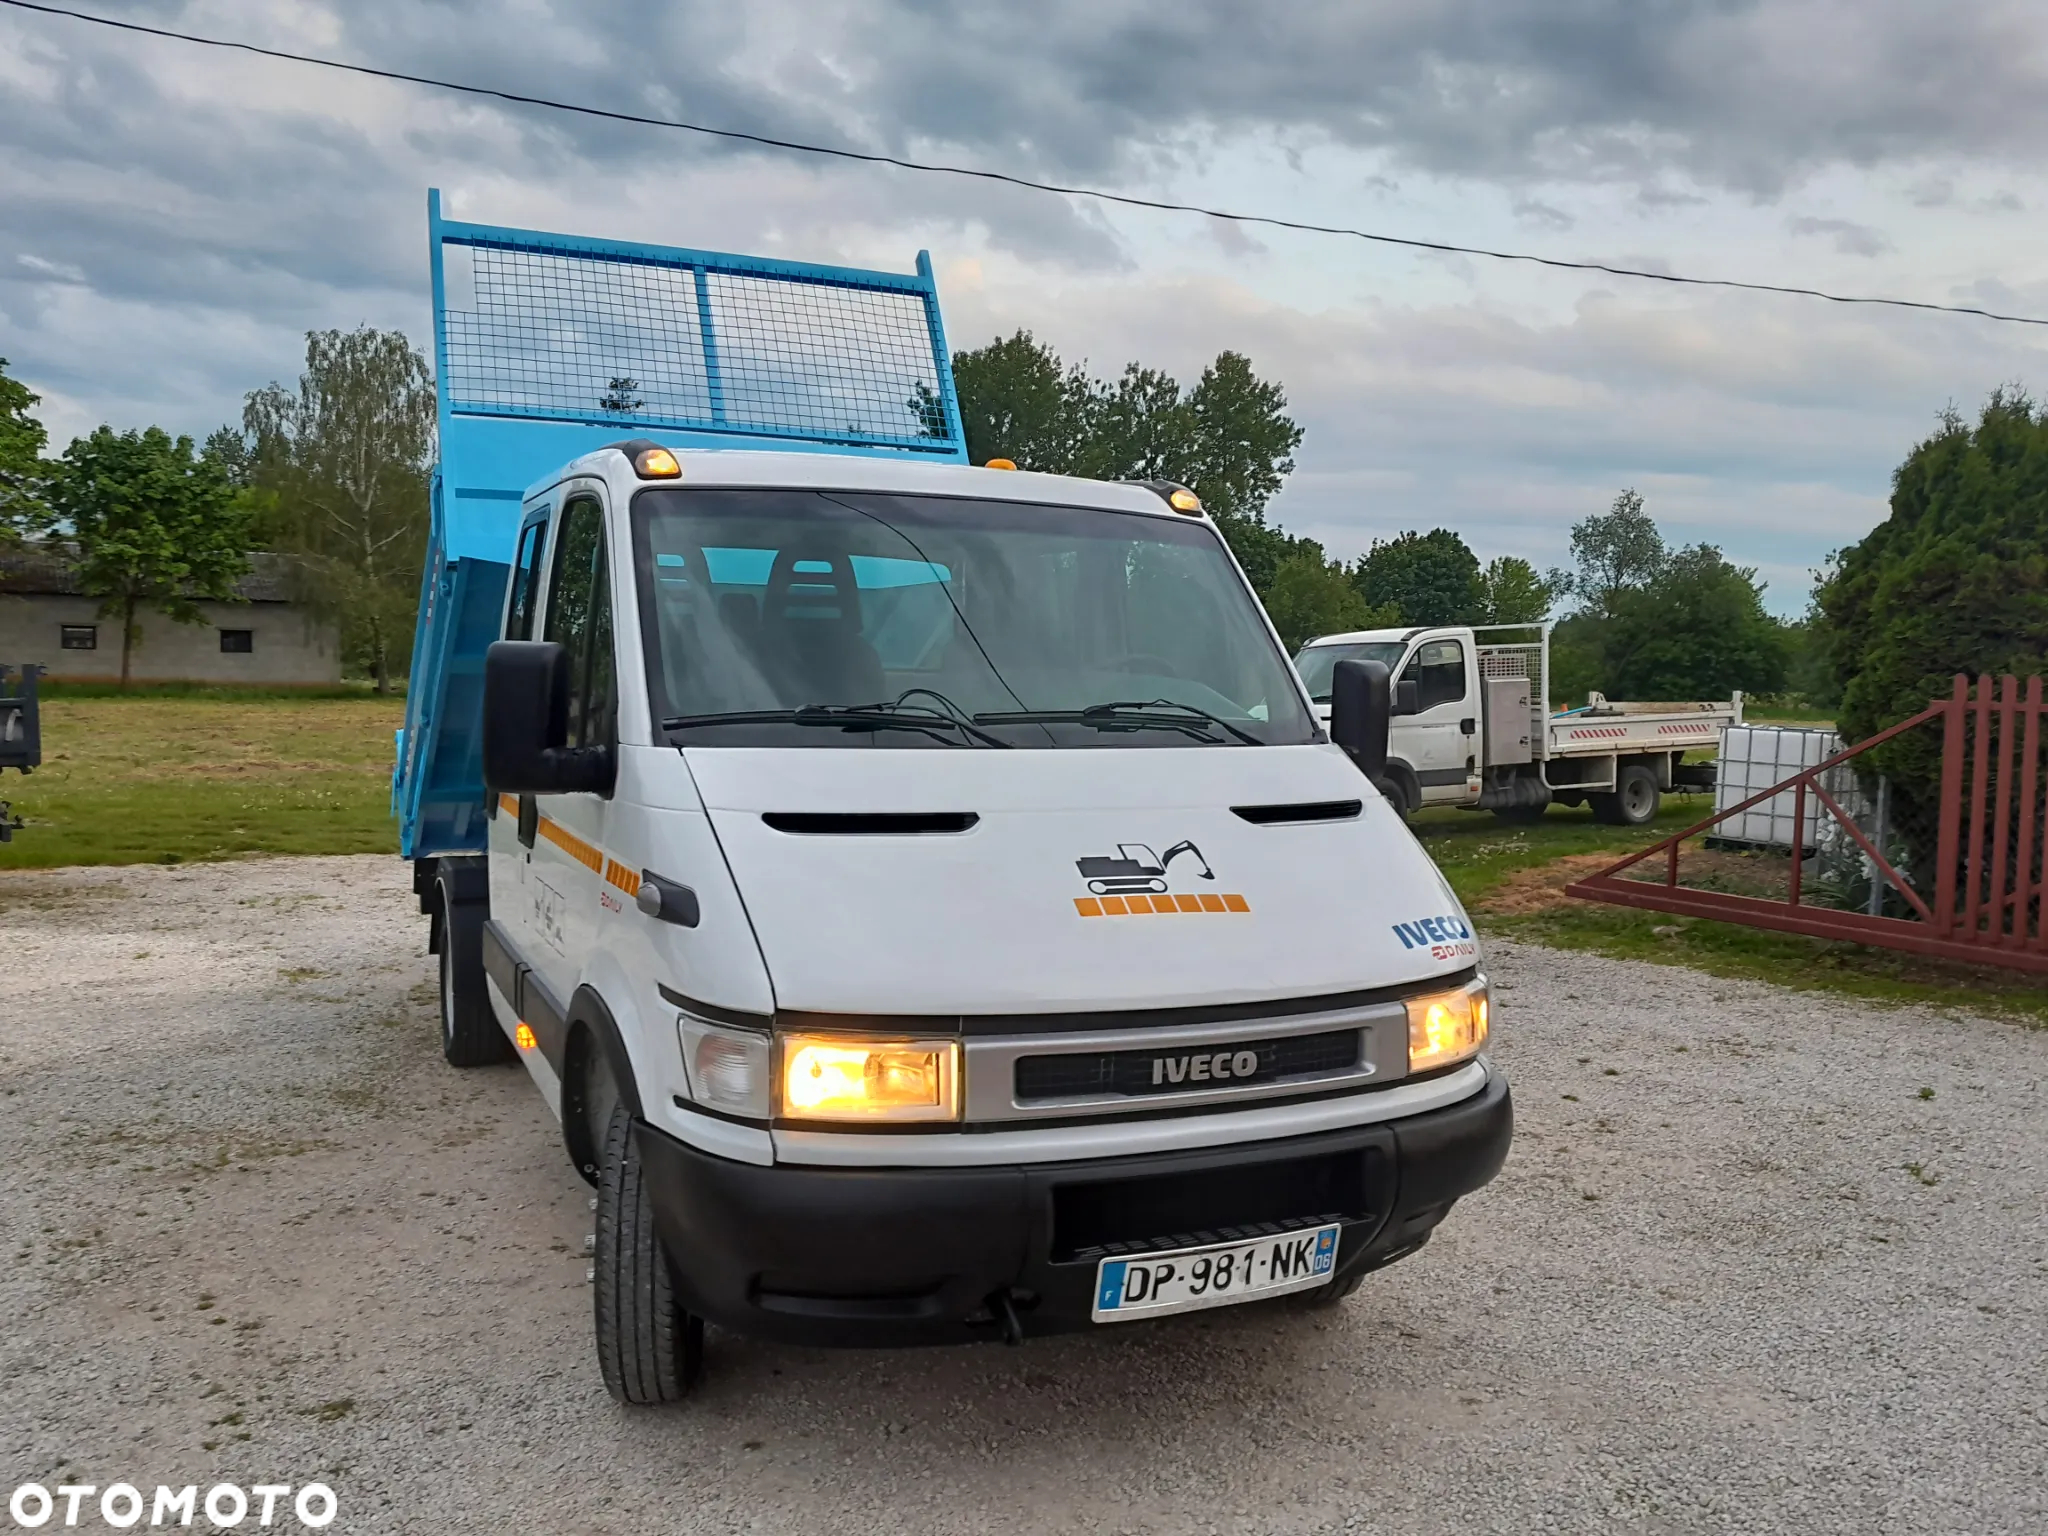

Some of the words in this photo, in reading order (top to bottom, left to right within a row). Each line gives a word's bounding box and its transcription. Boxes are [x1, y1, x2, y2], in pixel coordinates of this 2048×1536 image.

[1392, 915, 1470, 949] IVECO
[1152, 1050, 1258, 1085] IVECO
[1104, 1290, 1113, 1302] F
[1314, 1253, 1332, 1270] 06
